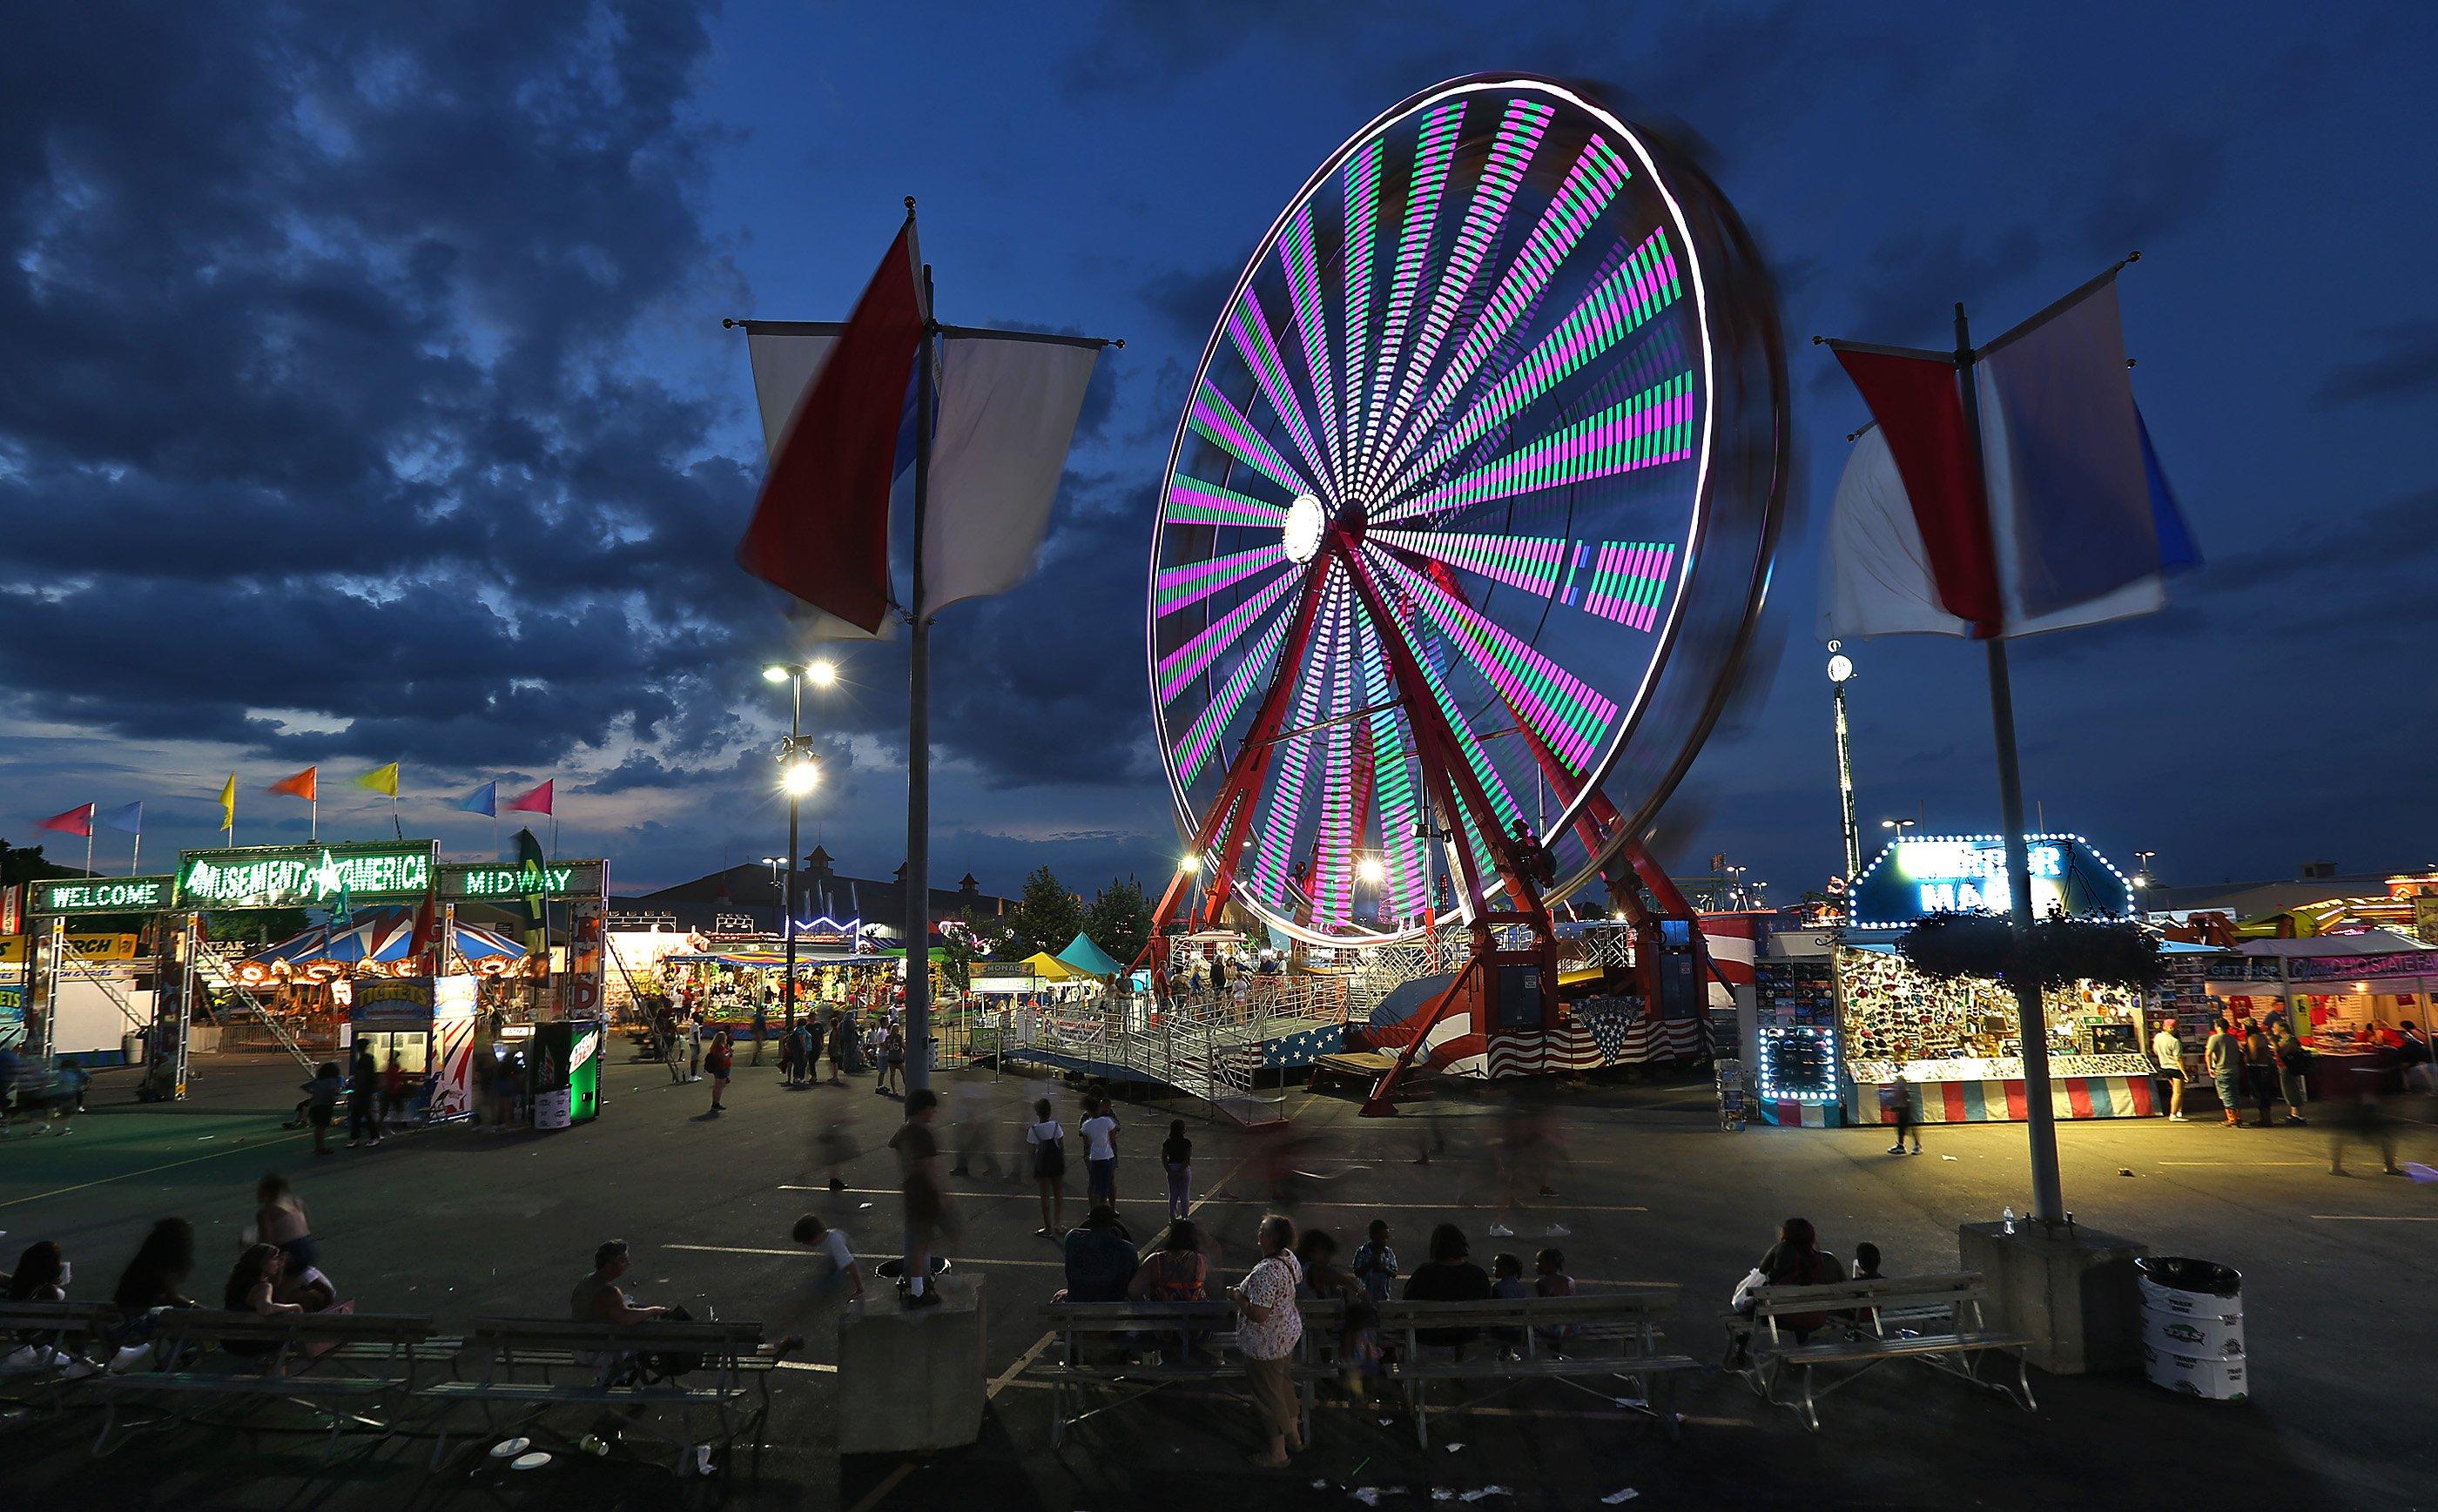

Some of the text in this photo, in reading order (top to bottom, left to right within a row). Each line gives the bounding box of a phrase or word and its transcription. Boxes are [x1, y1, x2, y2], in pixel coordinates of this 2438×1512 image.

[466, 869, 572, 894] MIDWAY
[53, 884, 159, 908] WELCOME
[203, 941, 246, 951] TEAK
[973, 964, 1028, 974] LEMONADE
[2212, 964, 2278, 976] GIFT SHOP
[2370, 955, 2415, 972] STATE
[357, 982, 428, 1008] TICKETS
